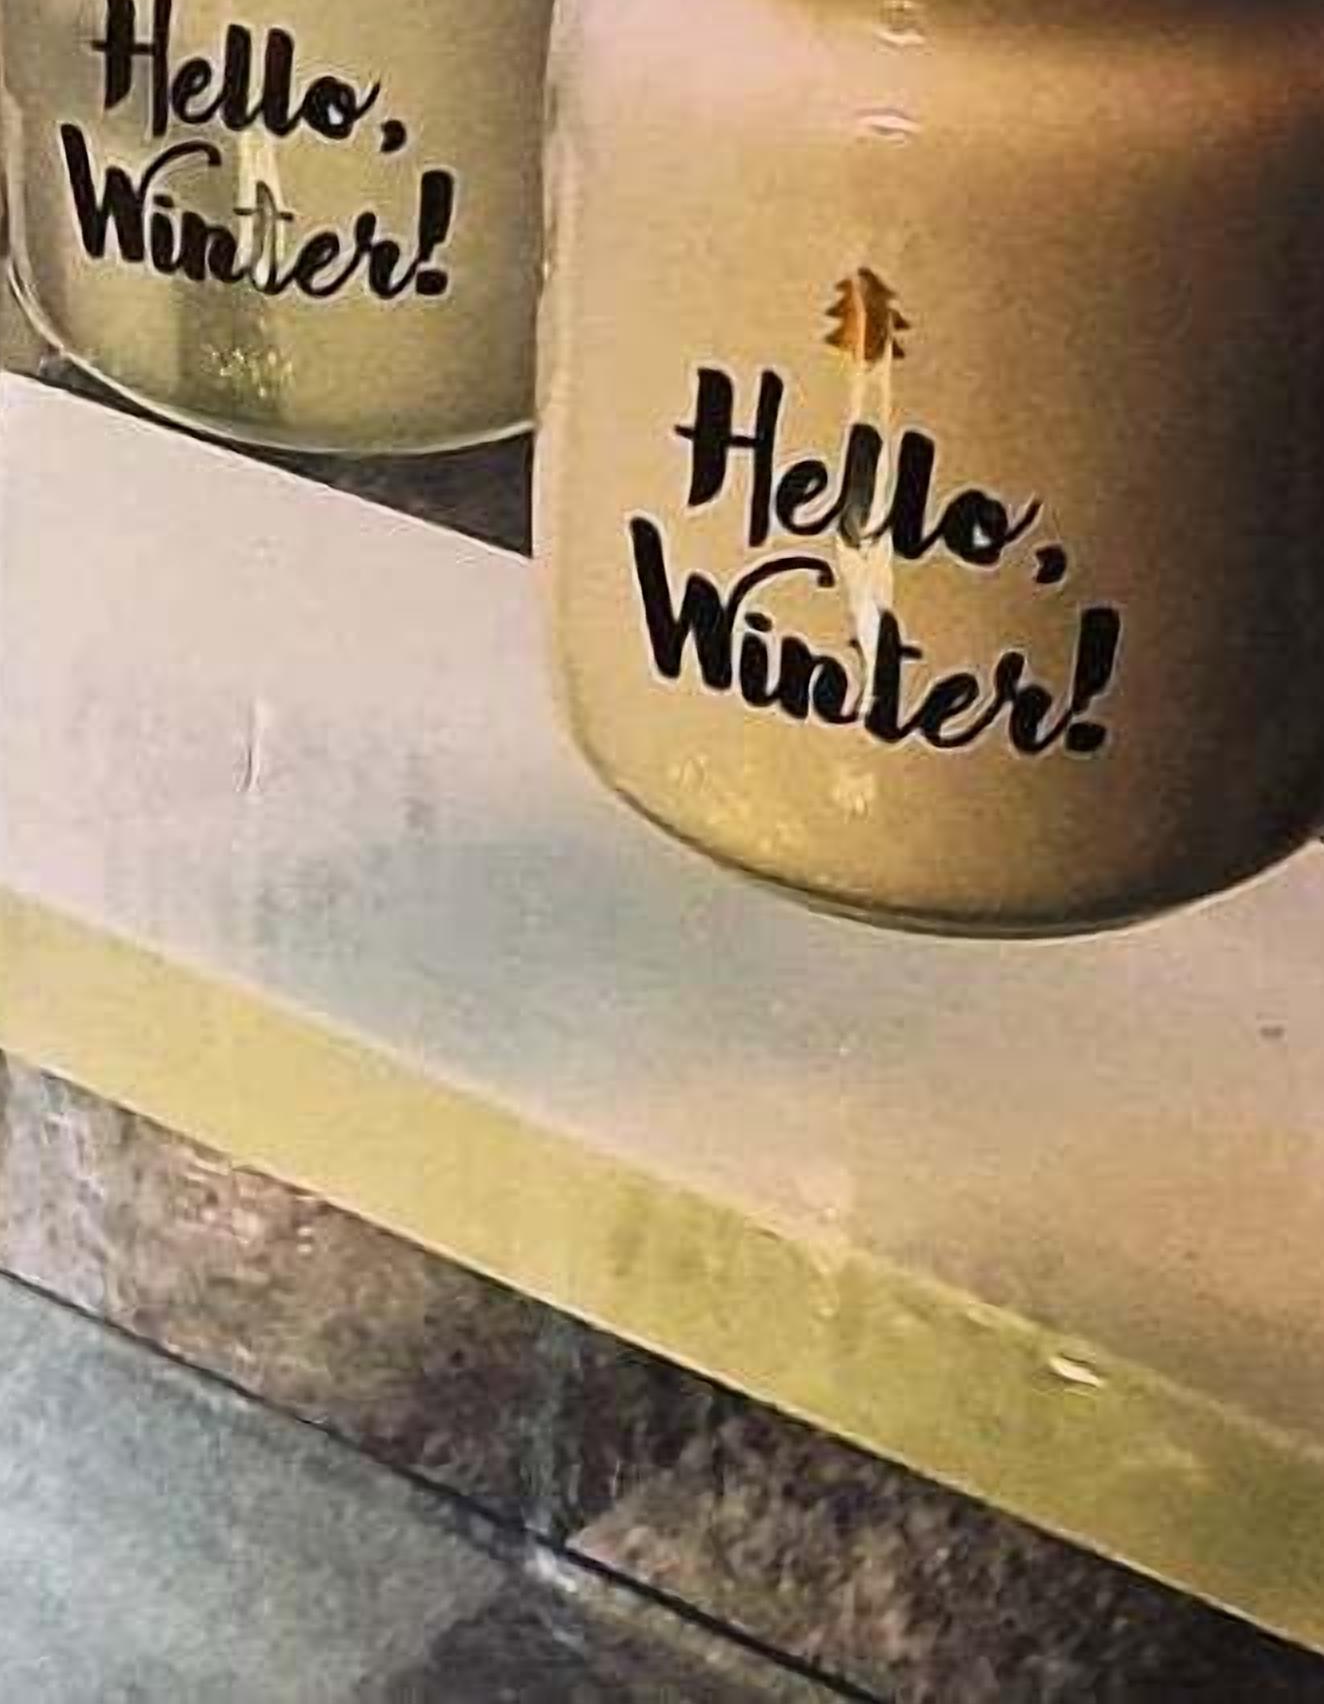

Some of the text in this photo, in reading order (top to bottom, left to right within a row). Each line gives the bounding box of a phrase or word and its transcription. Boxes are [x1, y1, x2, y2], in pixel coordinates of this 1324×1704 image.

[59, 122, 456, 300] Winter!
[674, 366, 1069, 585] Hello,
[629, 516, 1121, 756] Winter!
